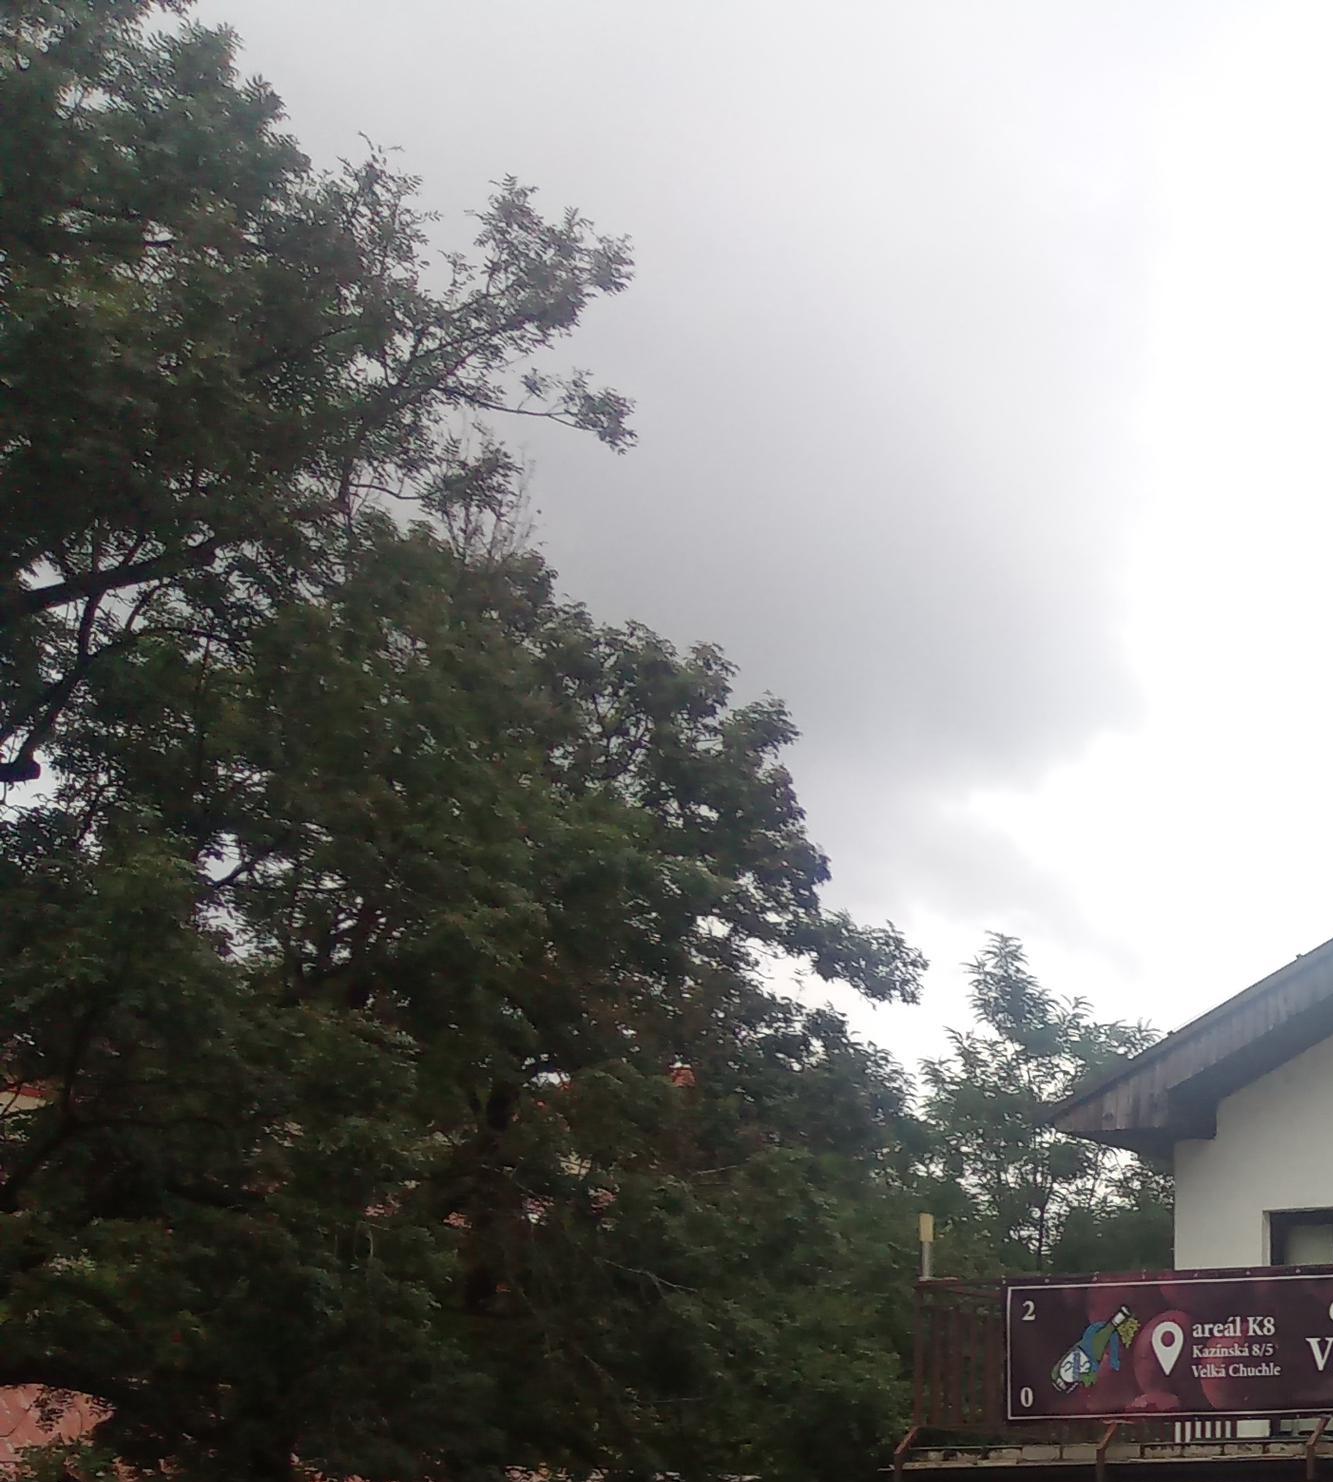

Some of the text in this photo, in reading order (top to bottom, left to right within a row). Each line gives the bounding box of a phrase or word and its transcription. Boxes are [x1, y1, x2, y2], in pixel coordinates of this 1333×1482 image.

[1022, 1300, 1036, 1321] 2
[1192, 1316, 1276, 1338] areál K8
[1252, 1344, 1274, 1358] 8/5
[1192, 1362, 1281, 1378] Velká Chuchle
[1020, 1387, 1034, 1408] 0
